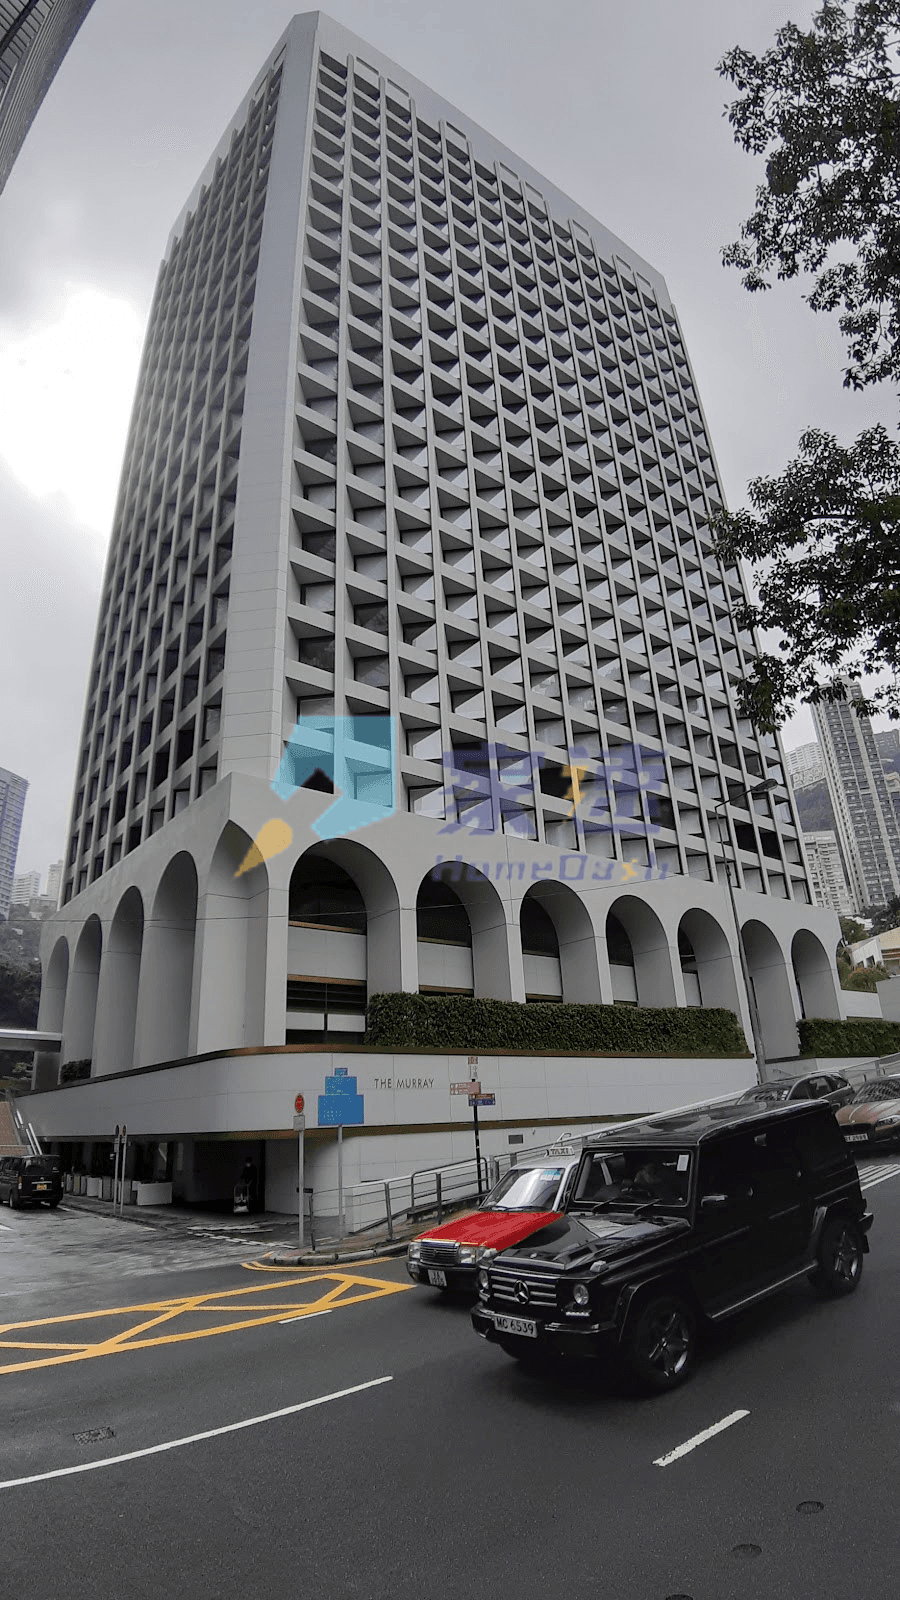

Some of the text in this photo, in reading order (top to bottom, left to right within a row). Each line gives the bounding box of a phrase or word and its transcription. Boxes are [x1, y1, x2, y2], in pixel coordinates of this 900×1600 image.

[374, 1078, 435, 1089] THE MURRAY
[496, 1317, 534, 1335] MC 6539
